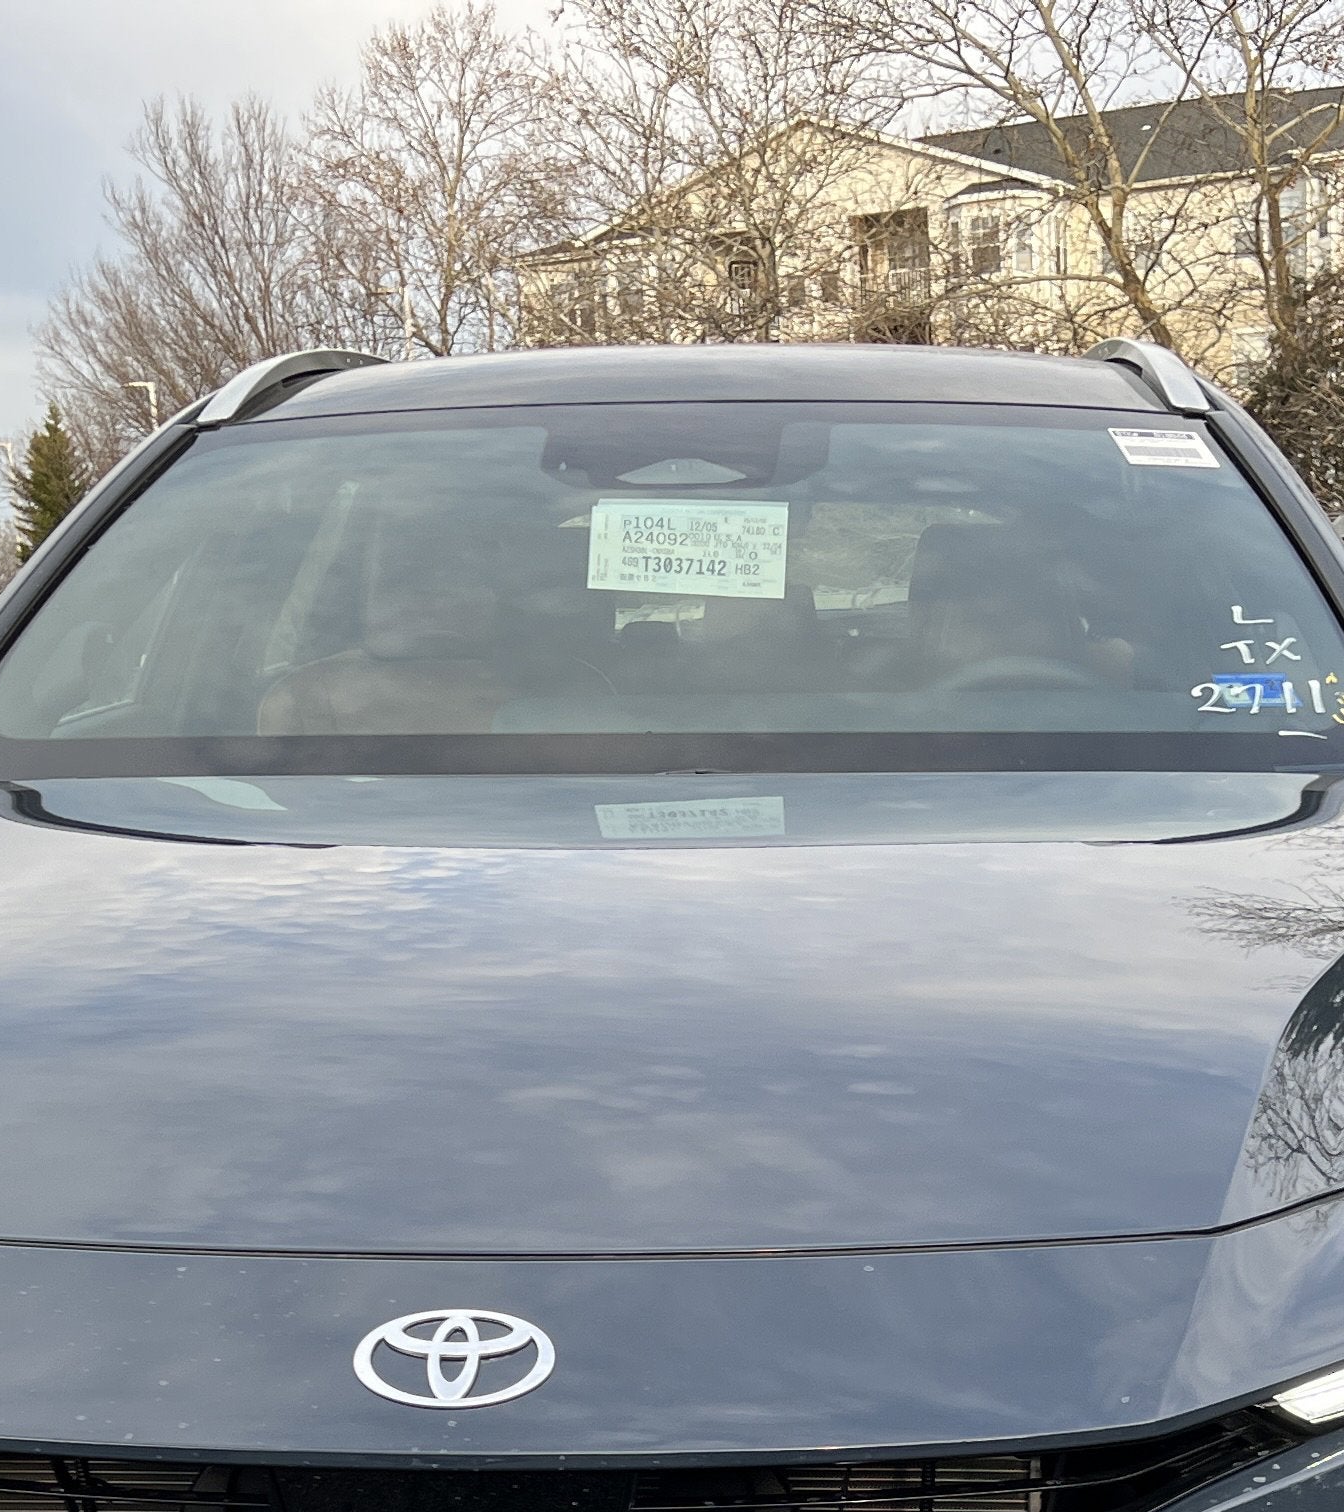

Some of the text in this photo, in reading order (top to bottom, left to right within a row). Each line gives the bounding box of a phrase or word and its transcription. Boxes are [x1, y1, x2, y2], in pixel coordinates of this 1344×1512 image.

[622, 530, 688, 546] A24092
[642, 556, 727, 577] T3037142
[735, 563, 760, 576] HB2
[1220, 637, 1302, 664] TX
